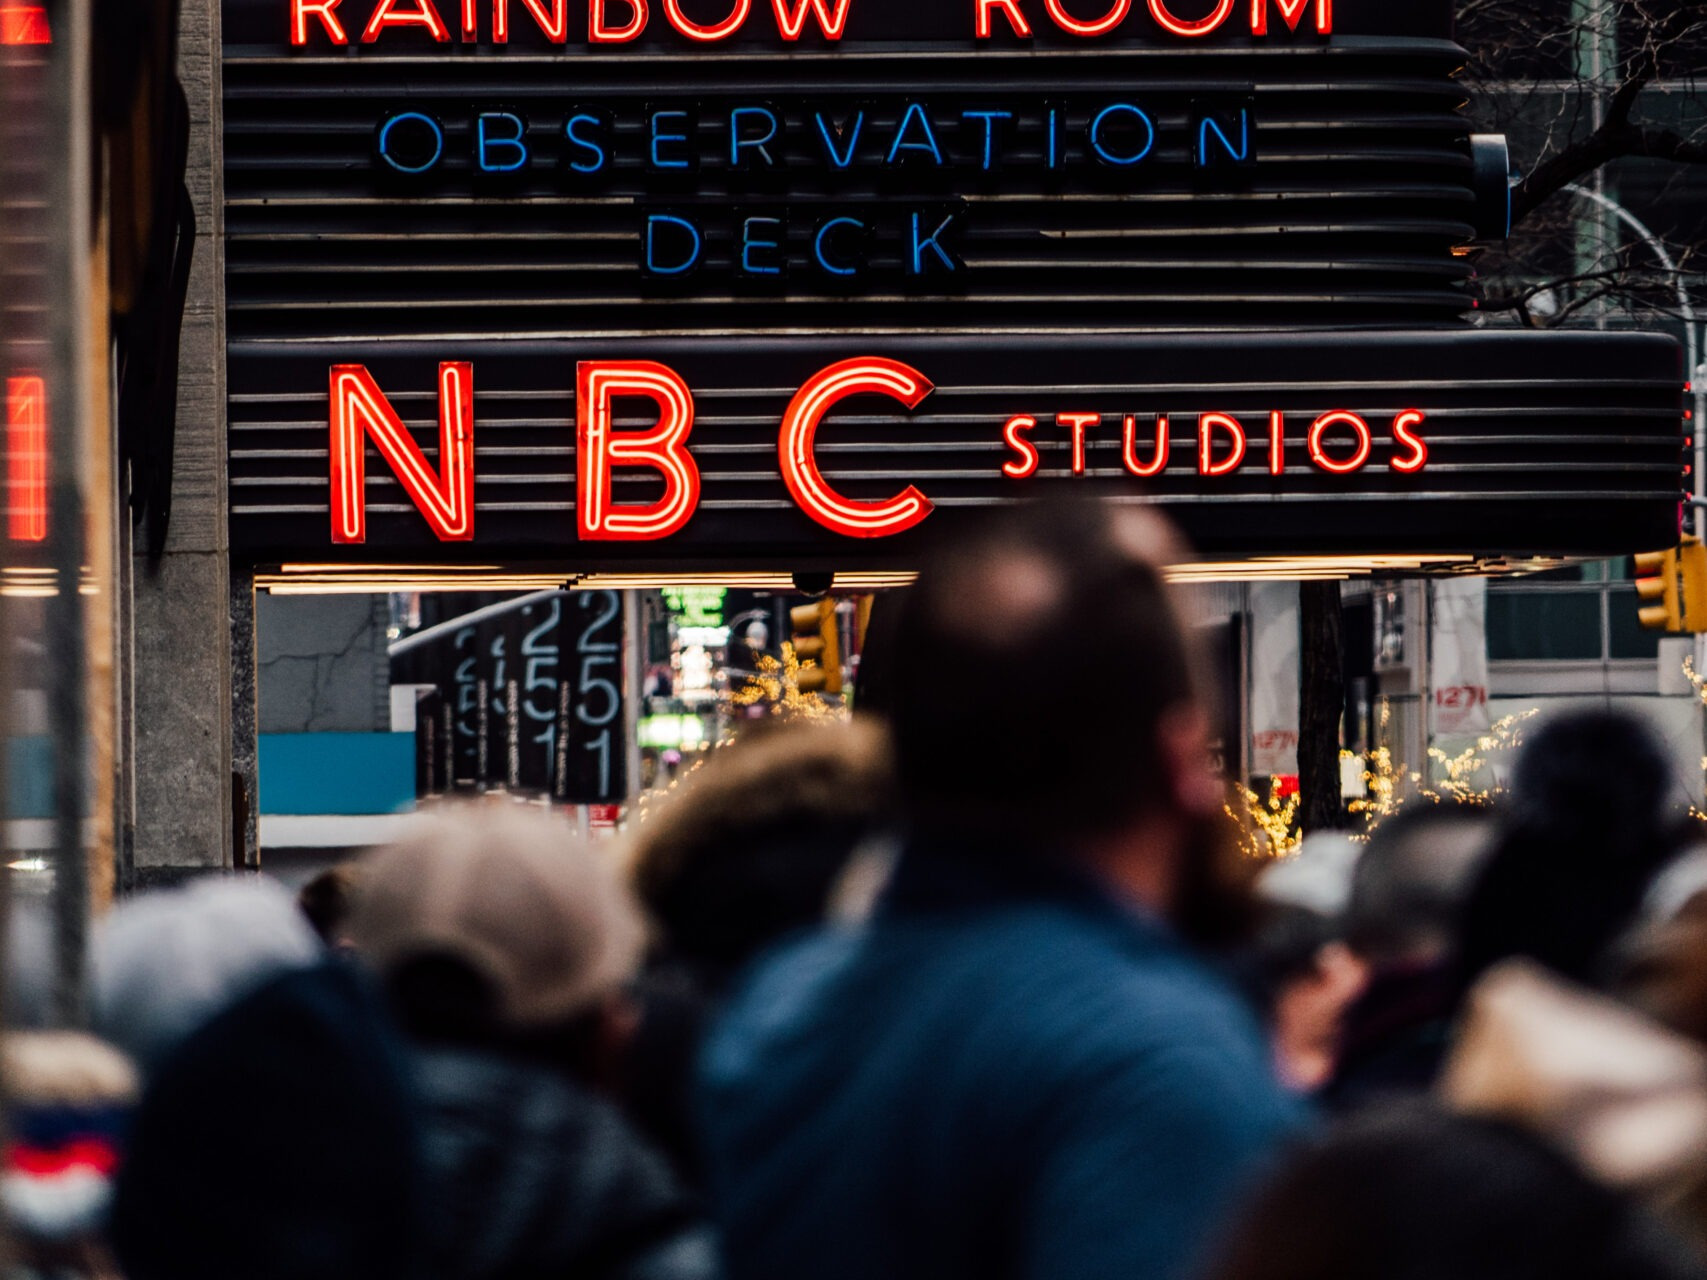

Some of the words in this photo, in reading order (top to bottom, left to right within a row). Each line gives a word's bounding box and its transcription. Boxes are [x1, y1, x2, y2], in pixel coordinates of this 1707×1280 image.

[378, 103, 1250, 173] OBSERVATION
[646, 213, 956, 275] DECK
[329, 356, 936, 543] NBC
[1002, 410, 1428, 478] STUDIOS
[1436, 686, 1486, 708] 1271
